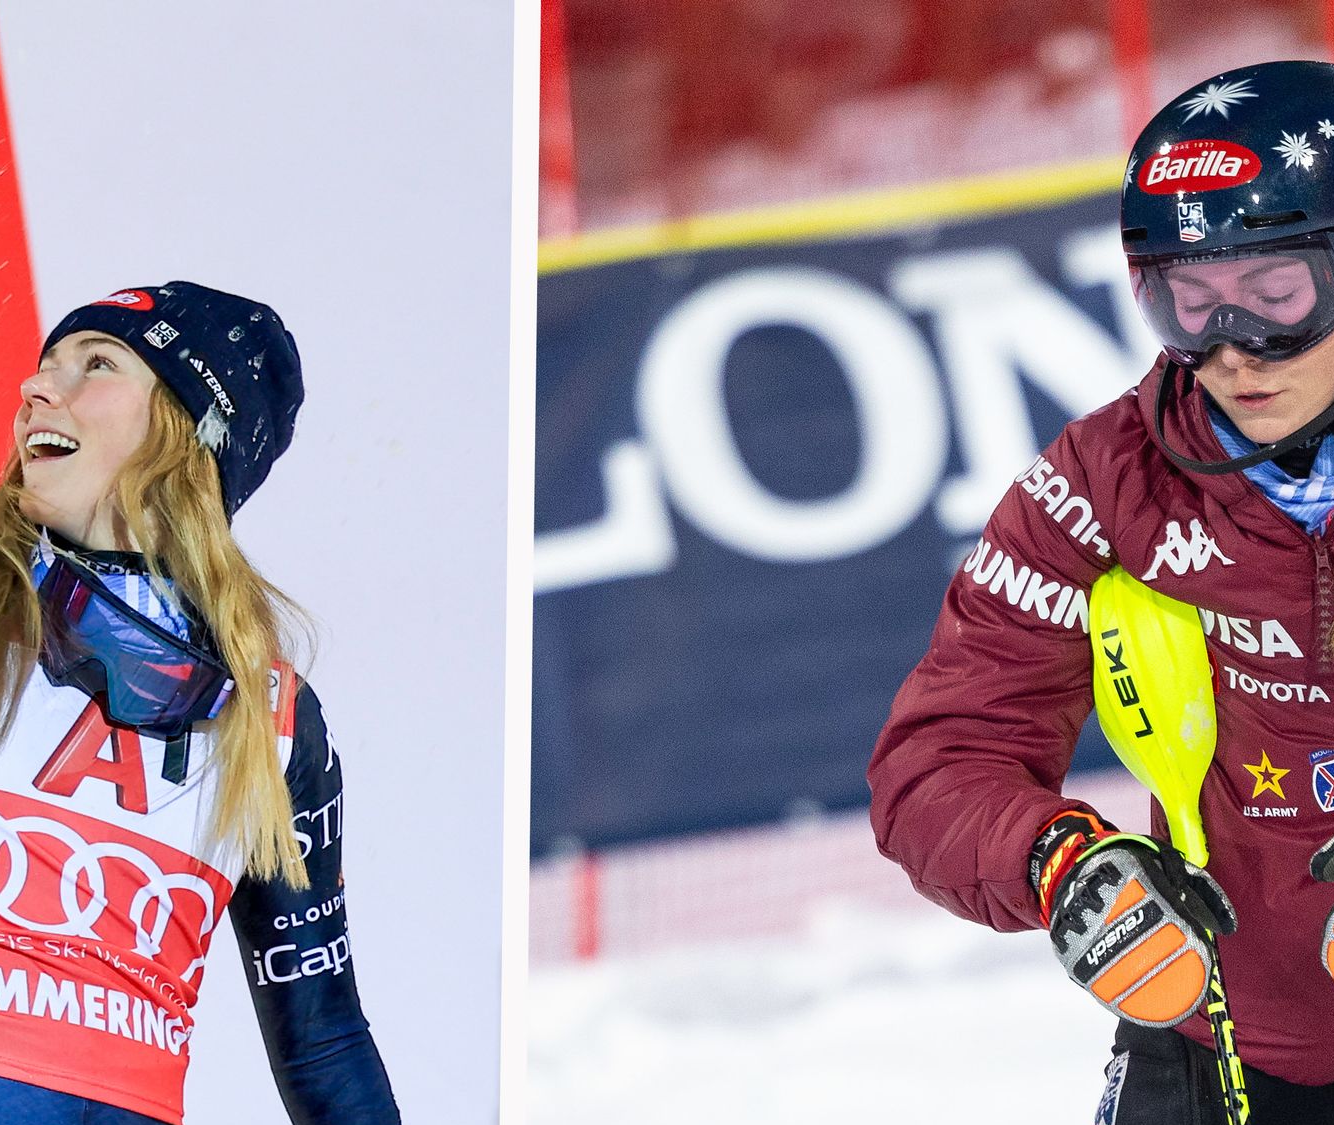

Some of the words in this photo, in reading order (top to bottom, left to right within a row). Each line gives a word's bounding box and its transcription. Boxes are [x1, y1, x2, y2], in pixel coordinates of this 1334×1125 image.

[1147, 150, 1244, 186] Barilla
[157, 321, 178, 338] US
[200, 368, 236, 417] TERREX
[1101, 628, 1154, 738] LEKI
[1224, 666, 1331, 703] TOYOTA
[1243, 806, 1263, 817] U.S.
[1264, 807, 1298, 817] ARMY
[273, 889, 344, 930] CLOUD
[44, 939, 88, 959] Ski
[1086, 909, 1145, 966] reusch
